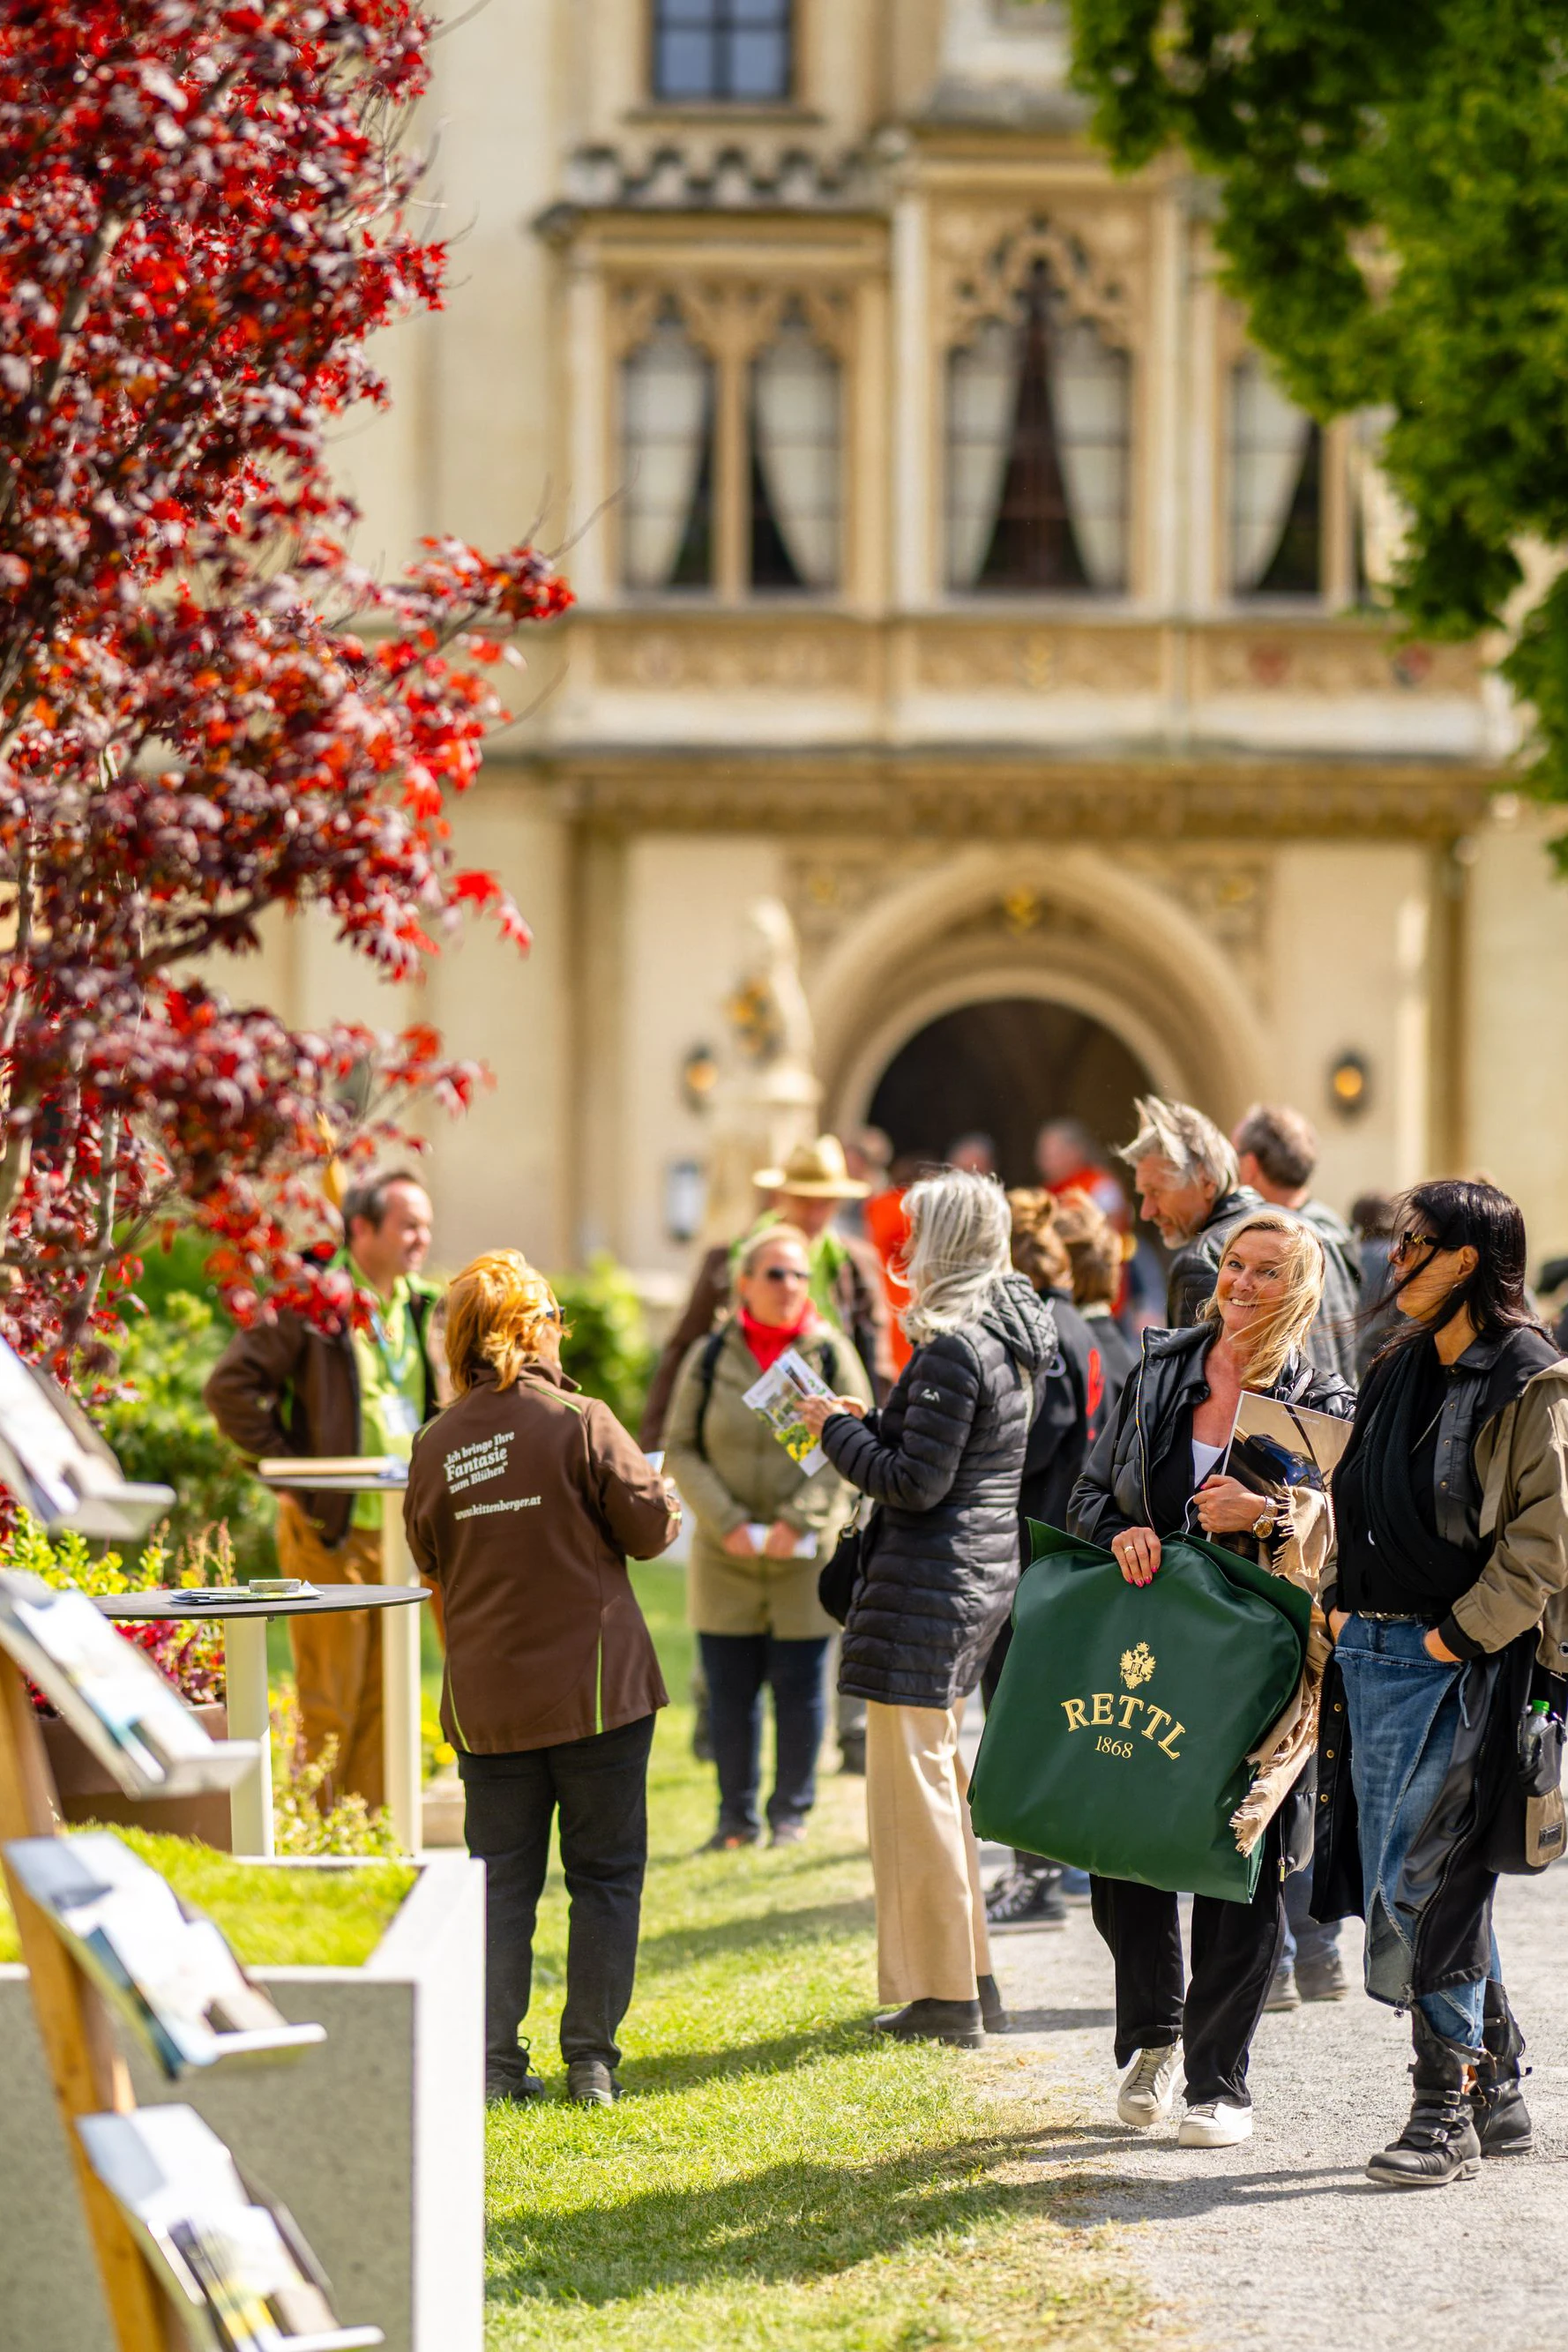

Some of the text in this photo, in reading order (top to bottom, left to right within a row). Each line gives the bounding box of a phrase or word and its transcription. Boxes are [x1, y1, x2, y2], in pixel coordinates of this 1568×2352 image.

[462, 1439, 493, 1457] bringe
[493, 1431, 515, 1446] Ihre
[445, 1446, 508, 1482] Fantasie
[449, 1478, 470, 1494] zum
[453, 1495, 541, 1521] www.kittenberger.at
[1061, 1693, 1186, 1760] RETTL
[1094, 1736, 1133, 1758] 1868
